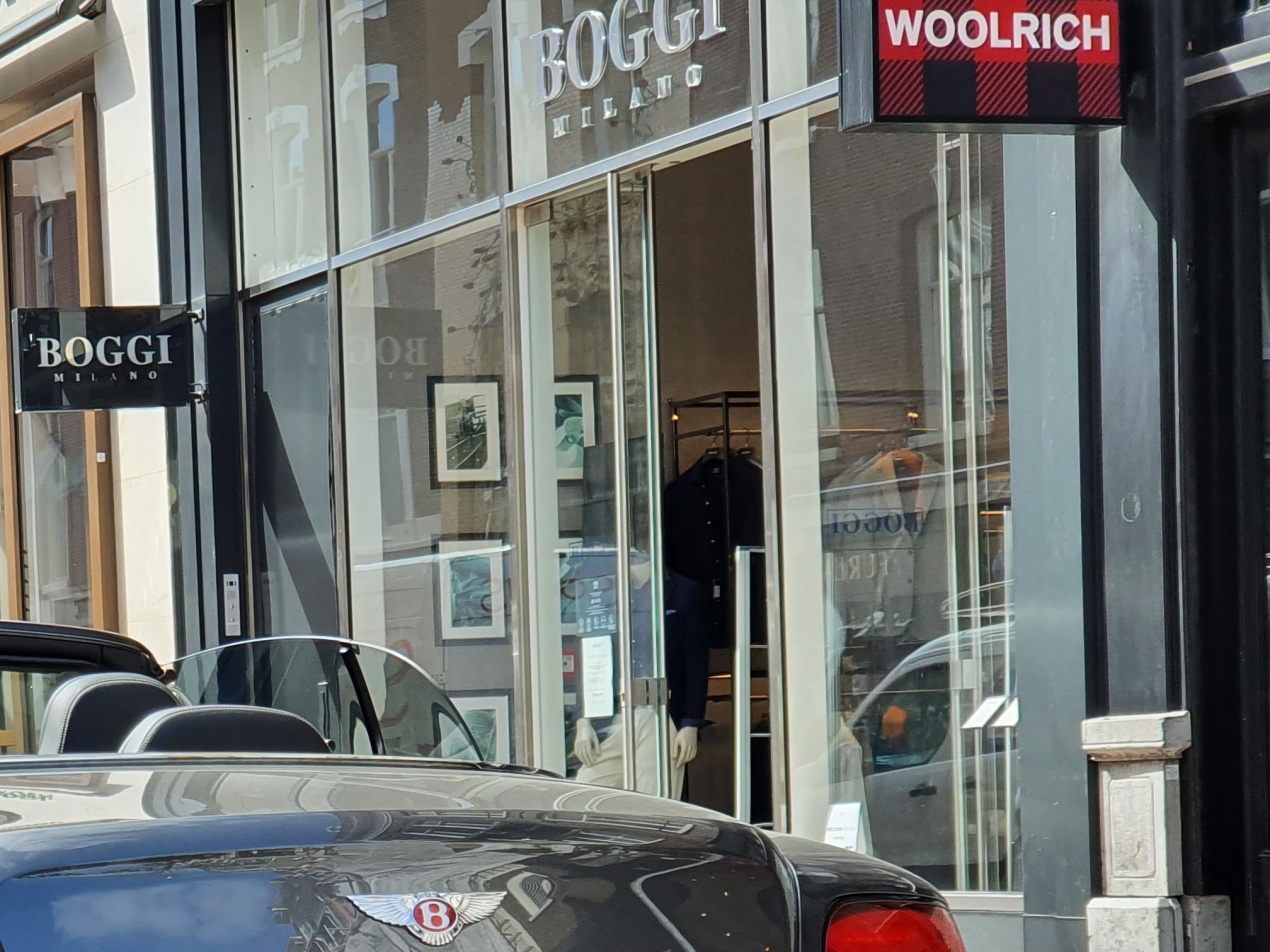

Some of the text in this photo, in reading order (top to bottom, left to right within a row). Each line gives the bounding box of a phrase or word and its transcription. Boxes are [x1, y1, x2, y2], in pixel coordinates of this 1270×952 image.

[885, 9, 1111, 50] WOOLRICH
[530, 0, 727, 105] BOGGI
[552, 64, 704, 139] MILANO
[36, 335, 173, 368] BOGGI
[53, 371, 158, 382] MILANO
